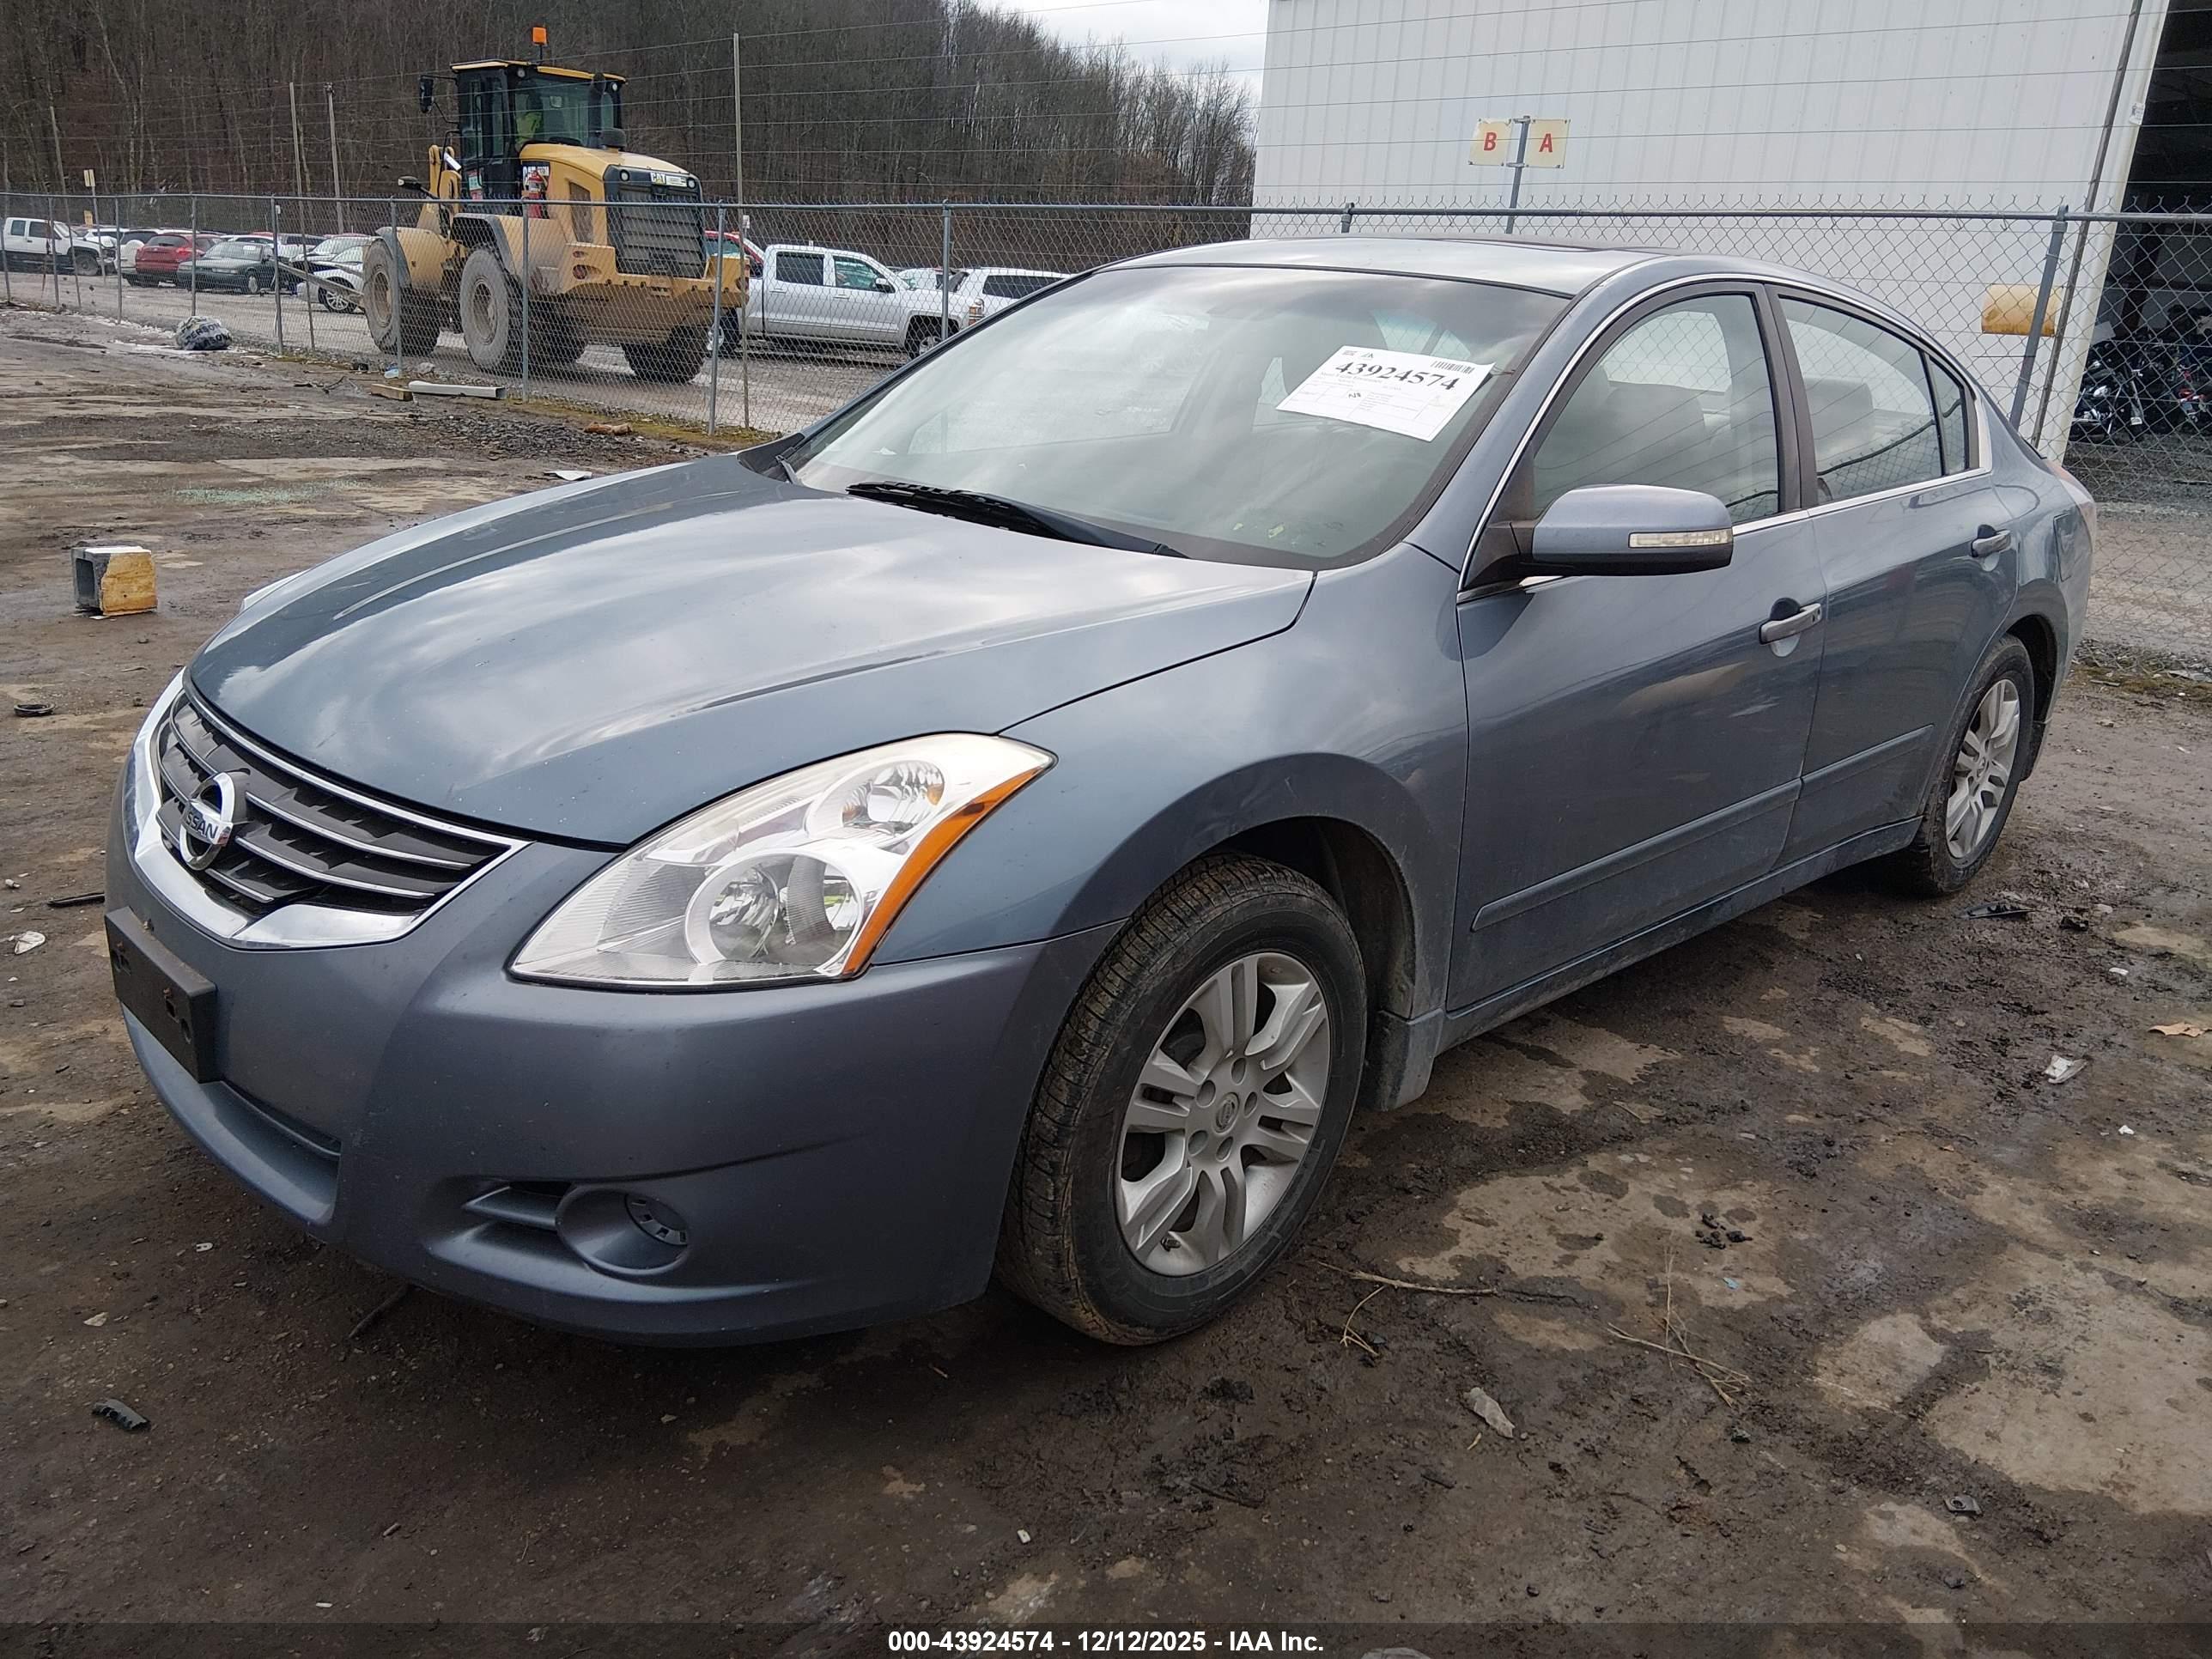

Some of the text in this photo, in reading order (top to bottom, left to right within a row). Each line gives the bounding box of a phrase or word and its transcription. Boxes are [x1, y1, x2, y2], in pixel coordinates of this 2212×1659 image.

[1483, 131, 1498, 151] B
[1538, 132, 1553, 153] A
[650, 172, 666, 185] CAT
[1335, 362, 1460, 390] 43924574
[185, 811, 219, 839] SSAN
